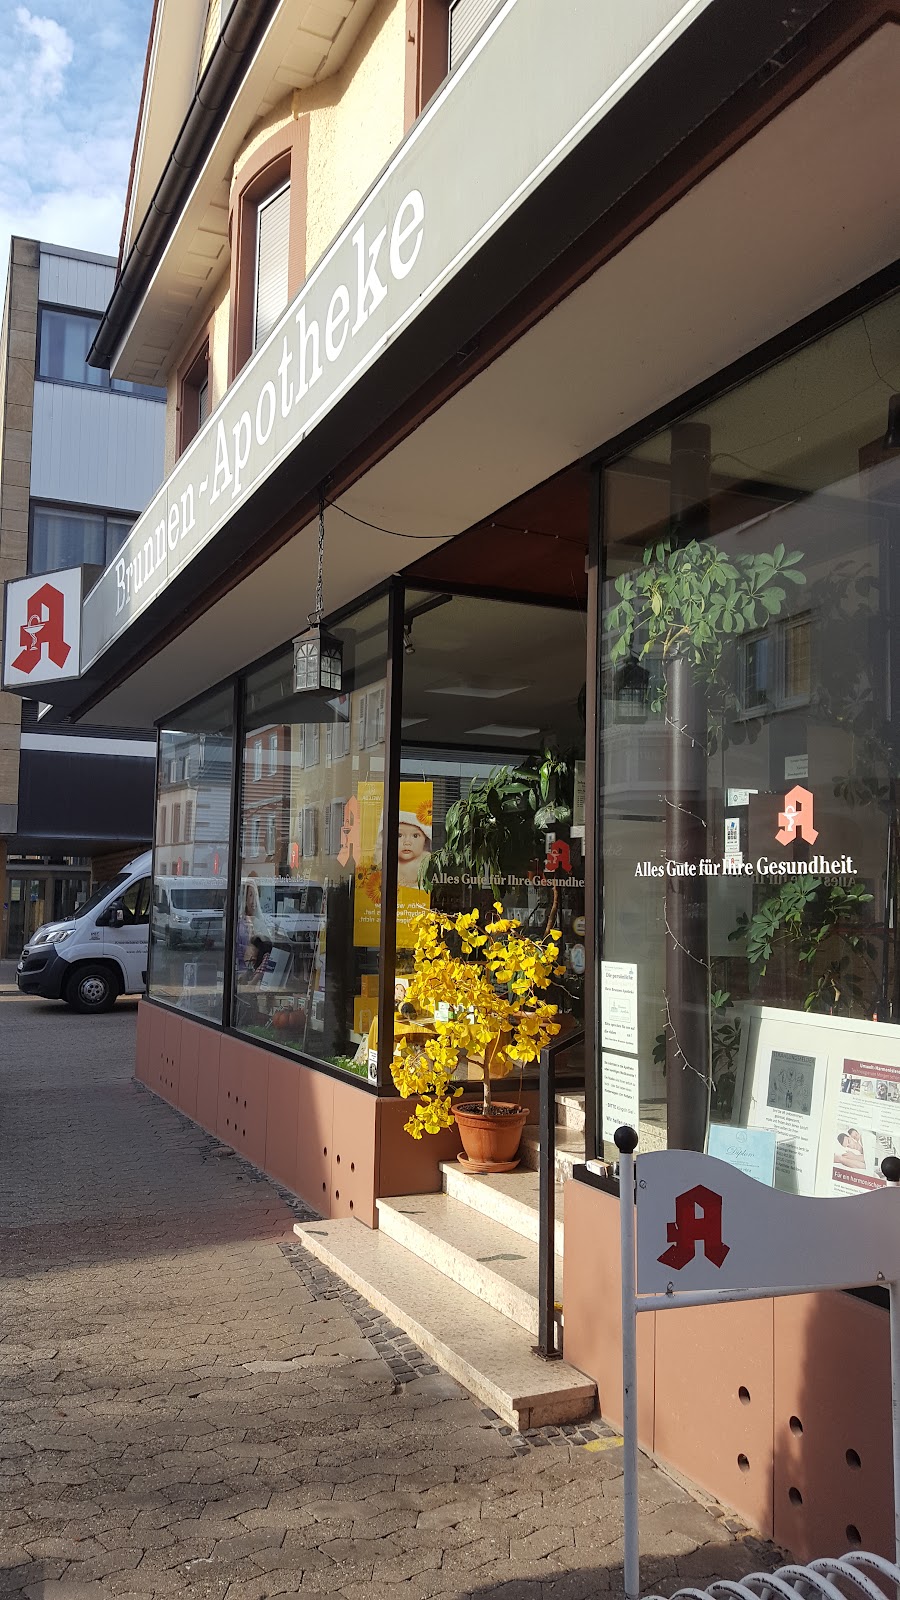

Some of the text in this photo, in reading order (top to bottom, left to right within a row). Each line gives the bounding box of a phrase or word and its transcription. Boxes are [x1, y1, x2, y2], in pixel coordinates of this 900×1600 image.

[634, 854, 858, 877] Alles Gute für Ihre Gesundheit.
[431, 873, 585, 887] Alles Gute für Ihre Gesundhe
